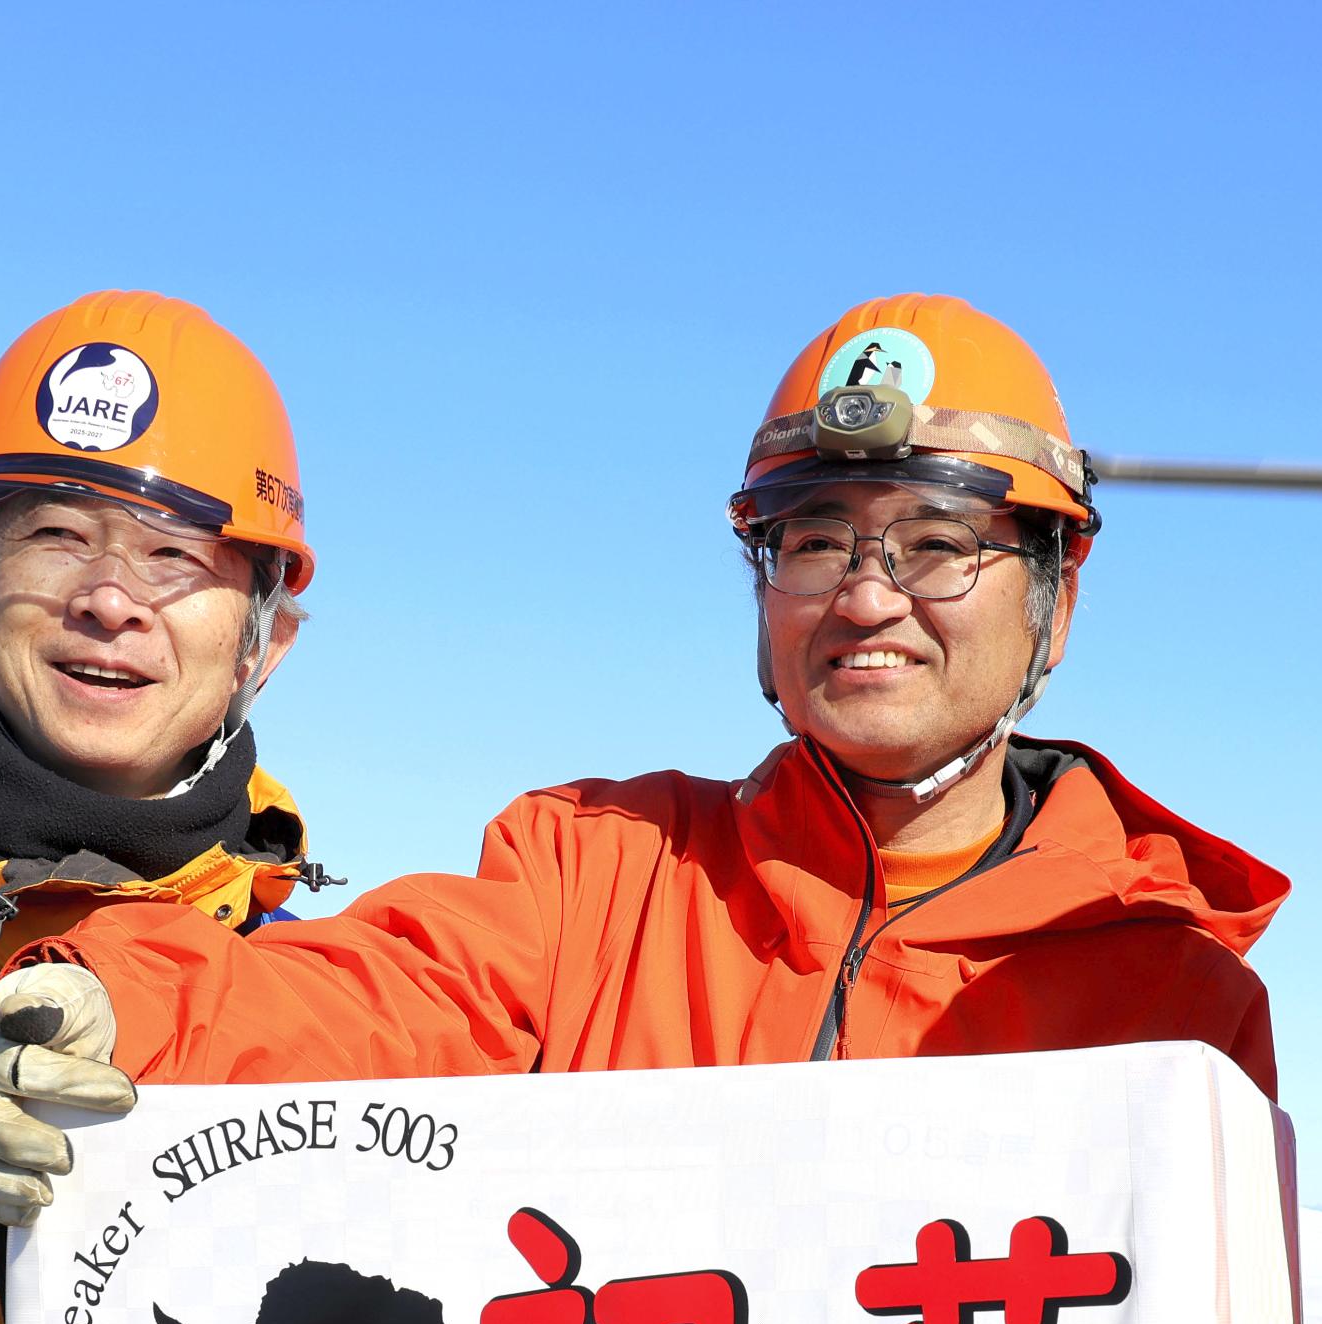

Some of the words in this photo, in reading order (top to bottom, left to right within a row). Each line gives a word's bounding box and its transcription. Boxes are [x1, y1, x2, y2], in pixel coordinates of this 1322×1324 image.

[114, 376, 130, 387] 67
[57, 395, 129, 424] JARE
[761, 424, 813, 445] Diamo
[151, 1099, 337, 1203] SHIRASE
[355, 1102, 459, 1171] 5003
